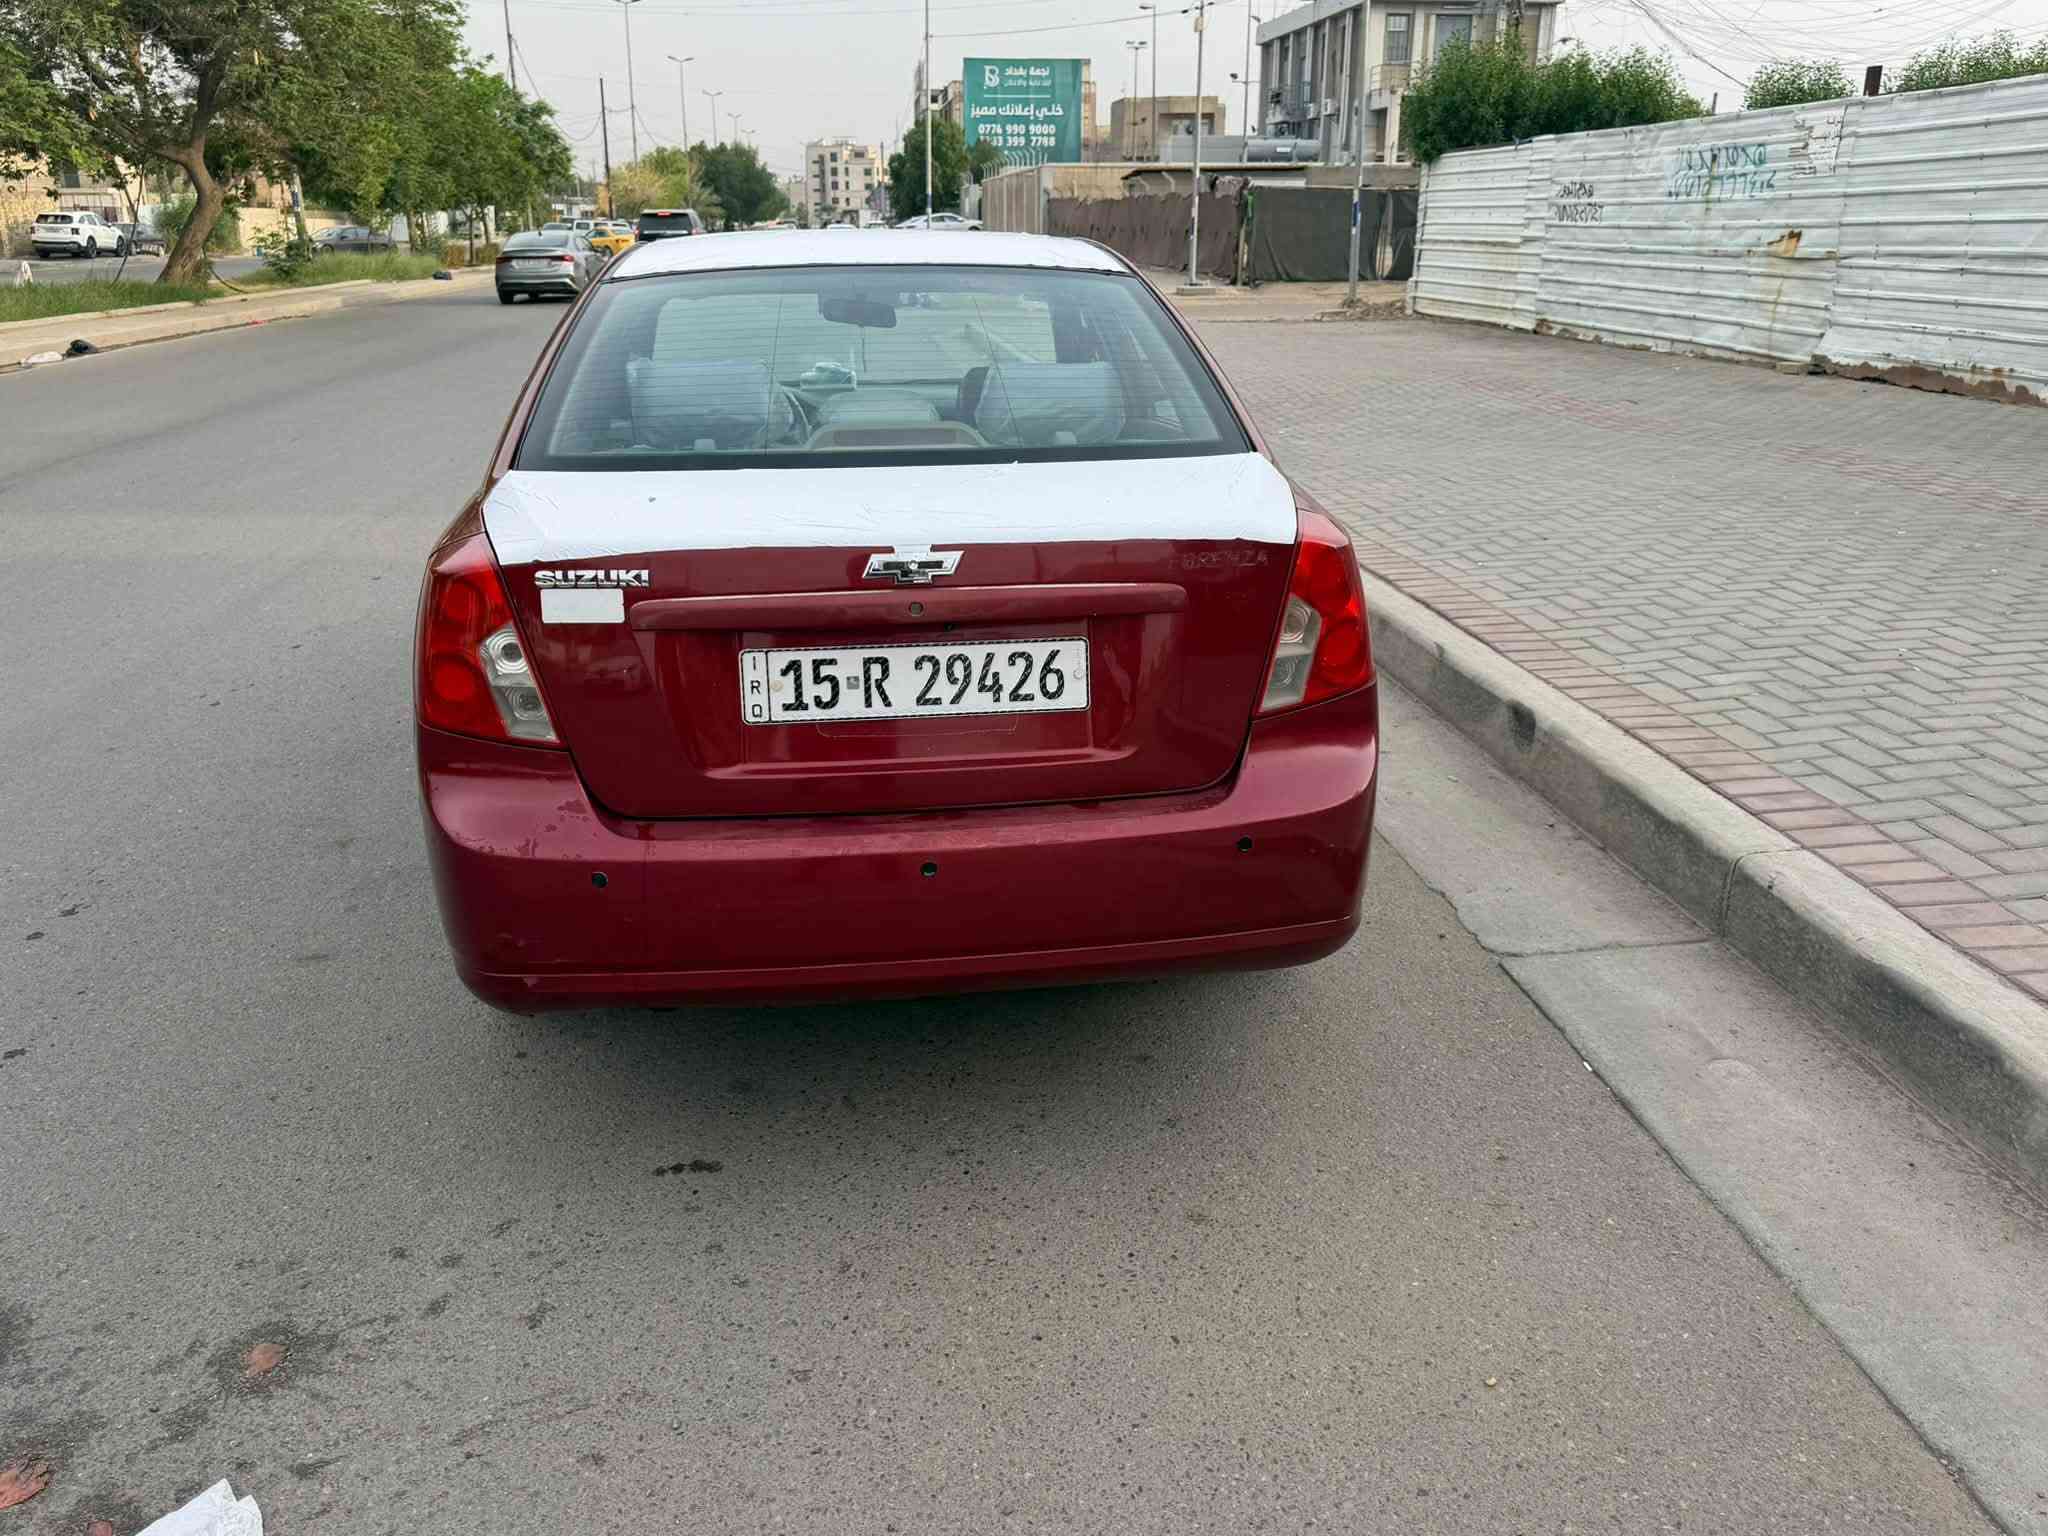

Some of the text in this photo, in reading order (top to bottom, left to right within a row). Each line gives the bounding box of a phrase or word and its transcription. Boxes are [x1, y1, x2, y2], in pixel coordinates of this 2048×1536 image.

[970, 104, 997, 119] مميز
[534, 569, 650, 588] SUZUKI
[750, 656, 762, 718] IRQ
[780, 658, 840, 711] 15
[862, 656, 892, 708] R
[914, 649, 1065, 706] 29426
